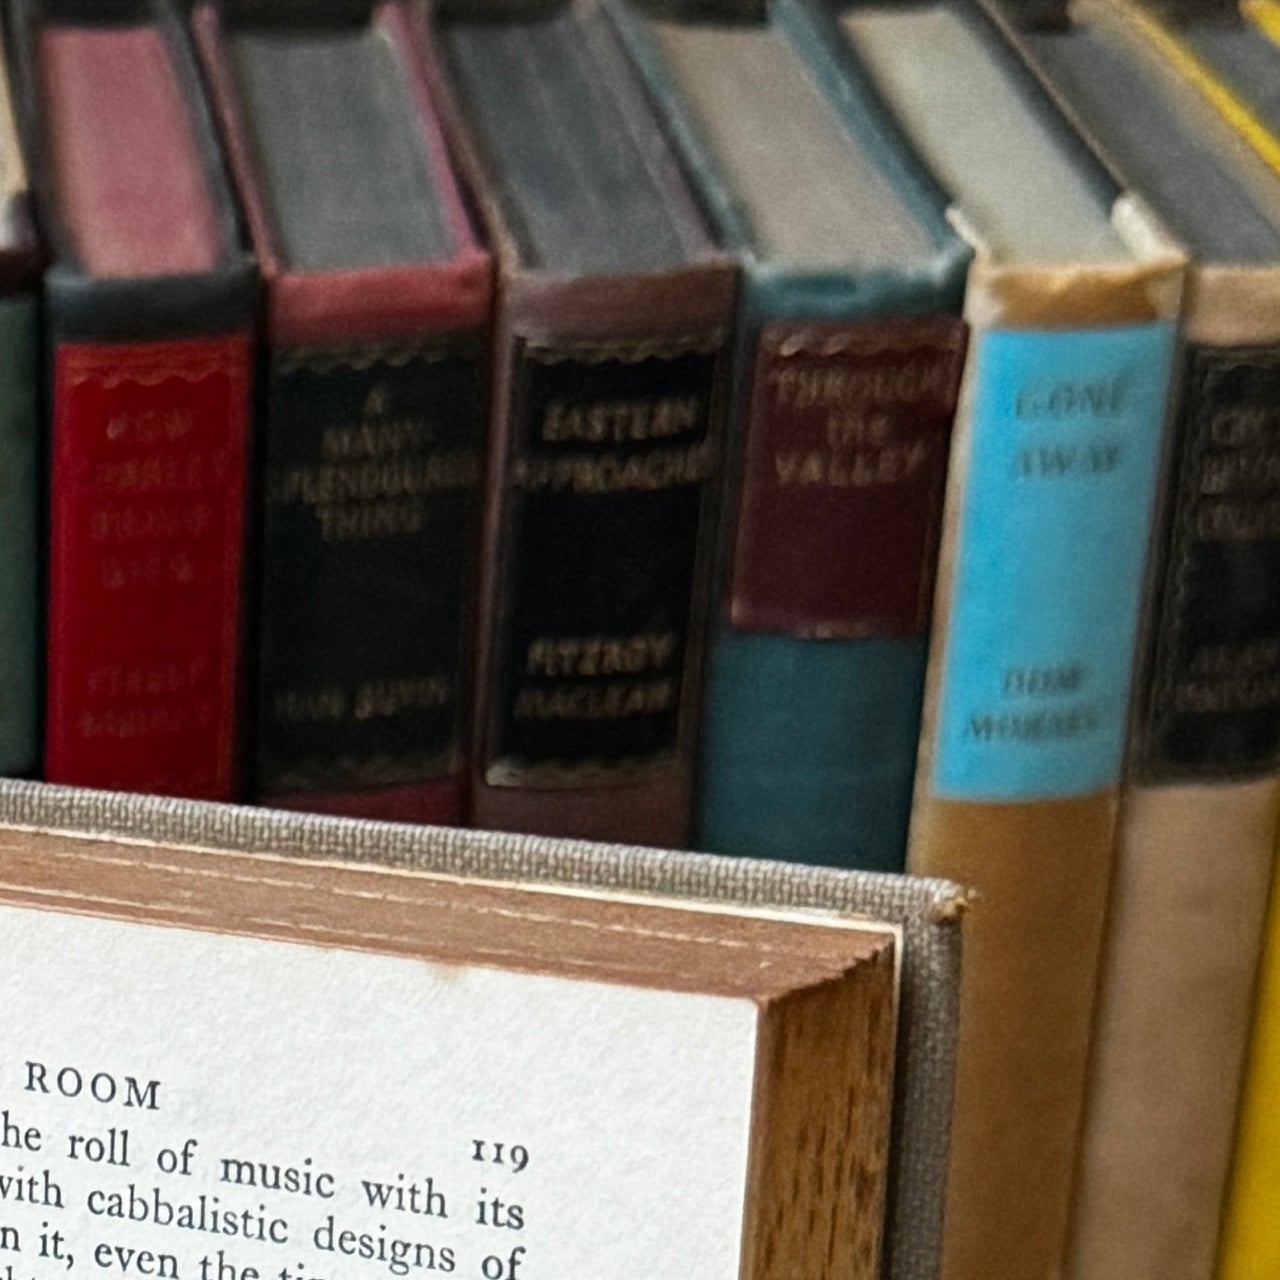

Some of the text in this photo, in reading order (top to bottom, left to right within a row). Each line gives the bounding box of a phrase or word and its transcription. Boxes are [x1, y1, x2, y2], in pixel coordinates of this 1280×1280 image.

[24, 1060, 161, 1111] ROOM
[67, 1127, 130, 1167] roll
[156, 1138, 199, 1176] of
[220, 1157, 335, 1199] music
[361, 1173, 448, 1219] with
[475, 1187, 525, 1231] its
[472, 1139, 529, 1174] 119
